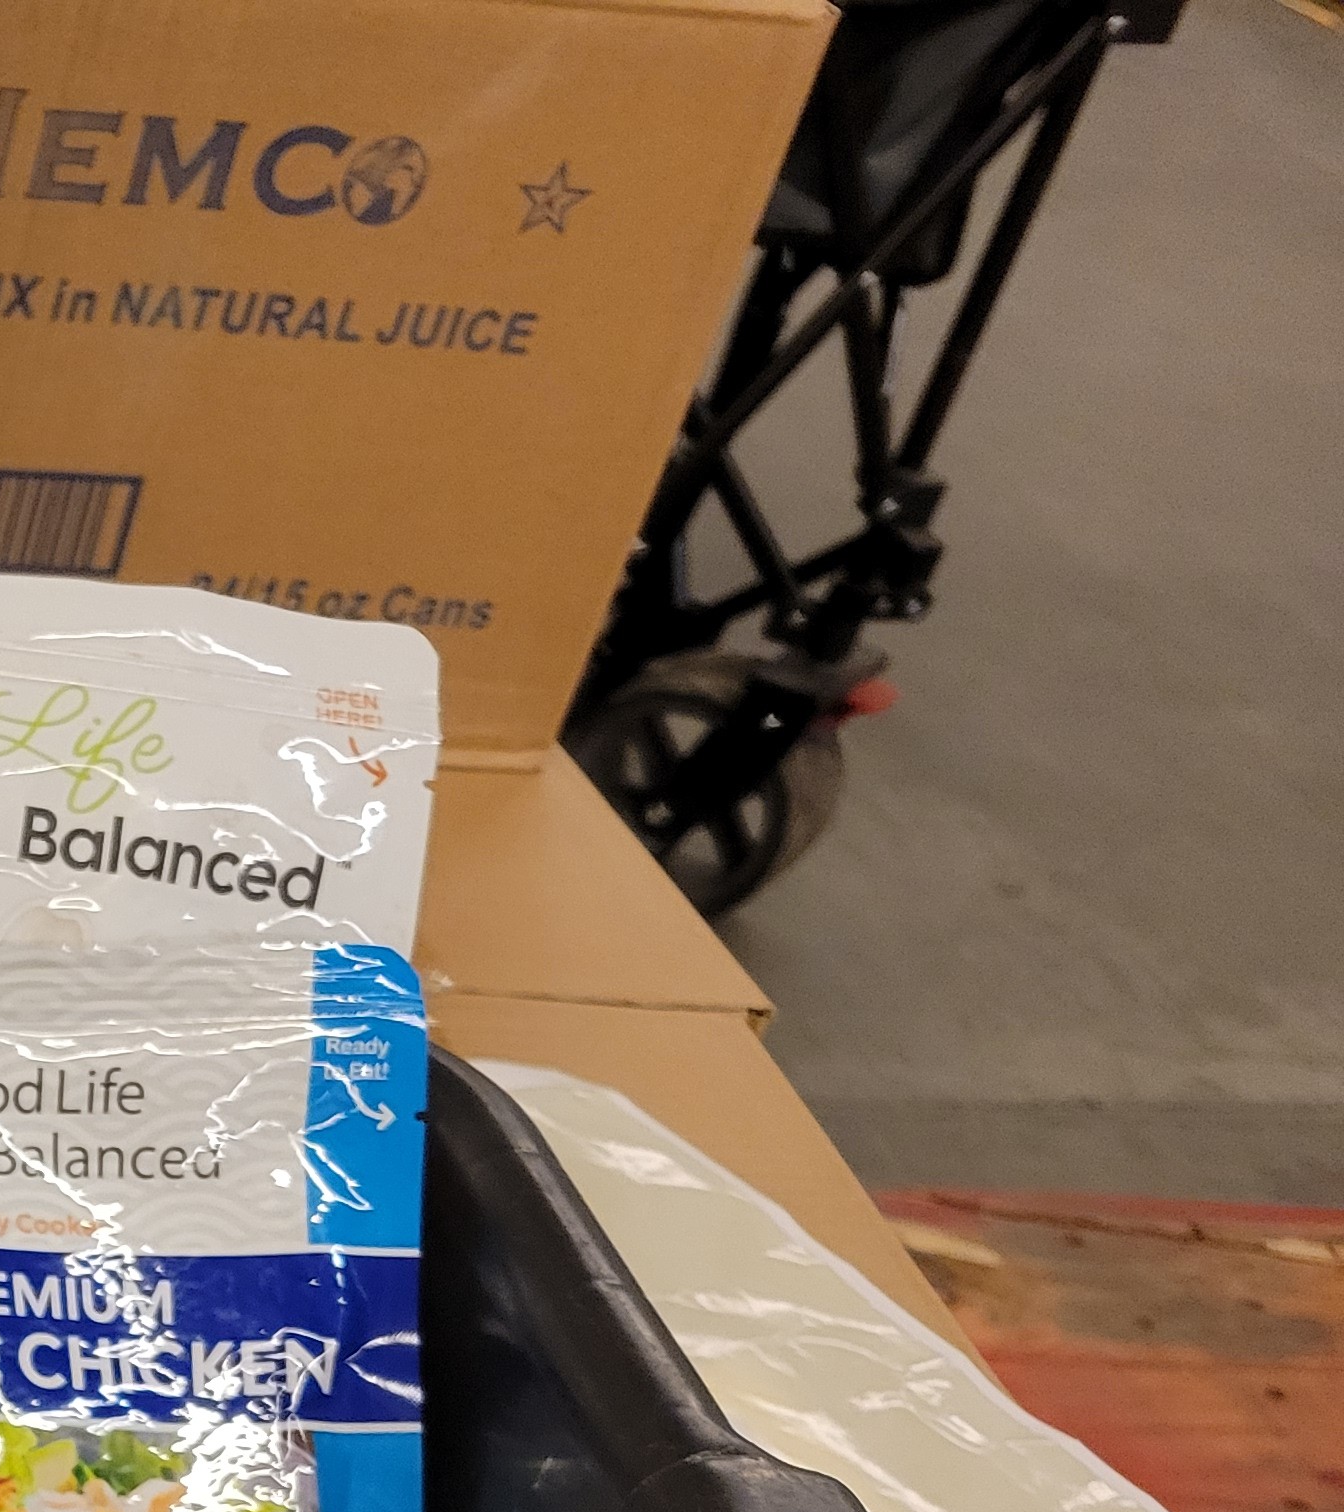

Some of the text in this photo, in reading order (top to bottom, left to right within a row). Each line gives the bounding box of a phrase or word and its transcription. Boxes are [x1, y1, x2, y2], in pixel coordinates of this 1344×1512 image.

[49, 278, 100, 323] in
[112, 282, 361, 344] NATURAL
[376, 301, 537, 356] JUICE
[315, 589, 370, 621] oz
[380, 584, 493, 630] Cans
[316, 687, 379, 710] OPEN
[18, 806, 324, 909] Balanced
[325, 1036, 391, 1060] Ready
[349, 1060, 391, 1081] Eat!
[57, 1067, 146, 1116] Life
[15, 1210, 111, 1240] Cooke
[19, 1336, 339, 1398] CHICKEN
